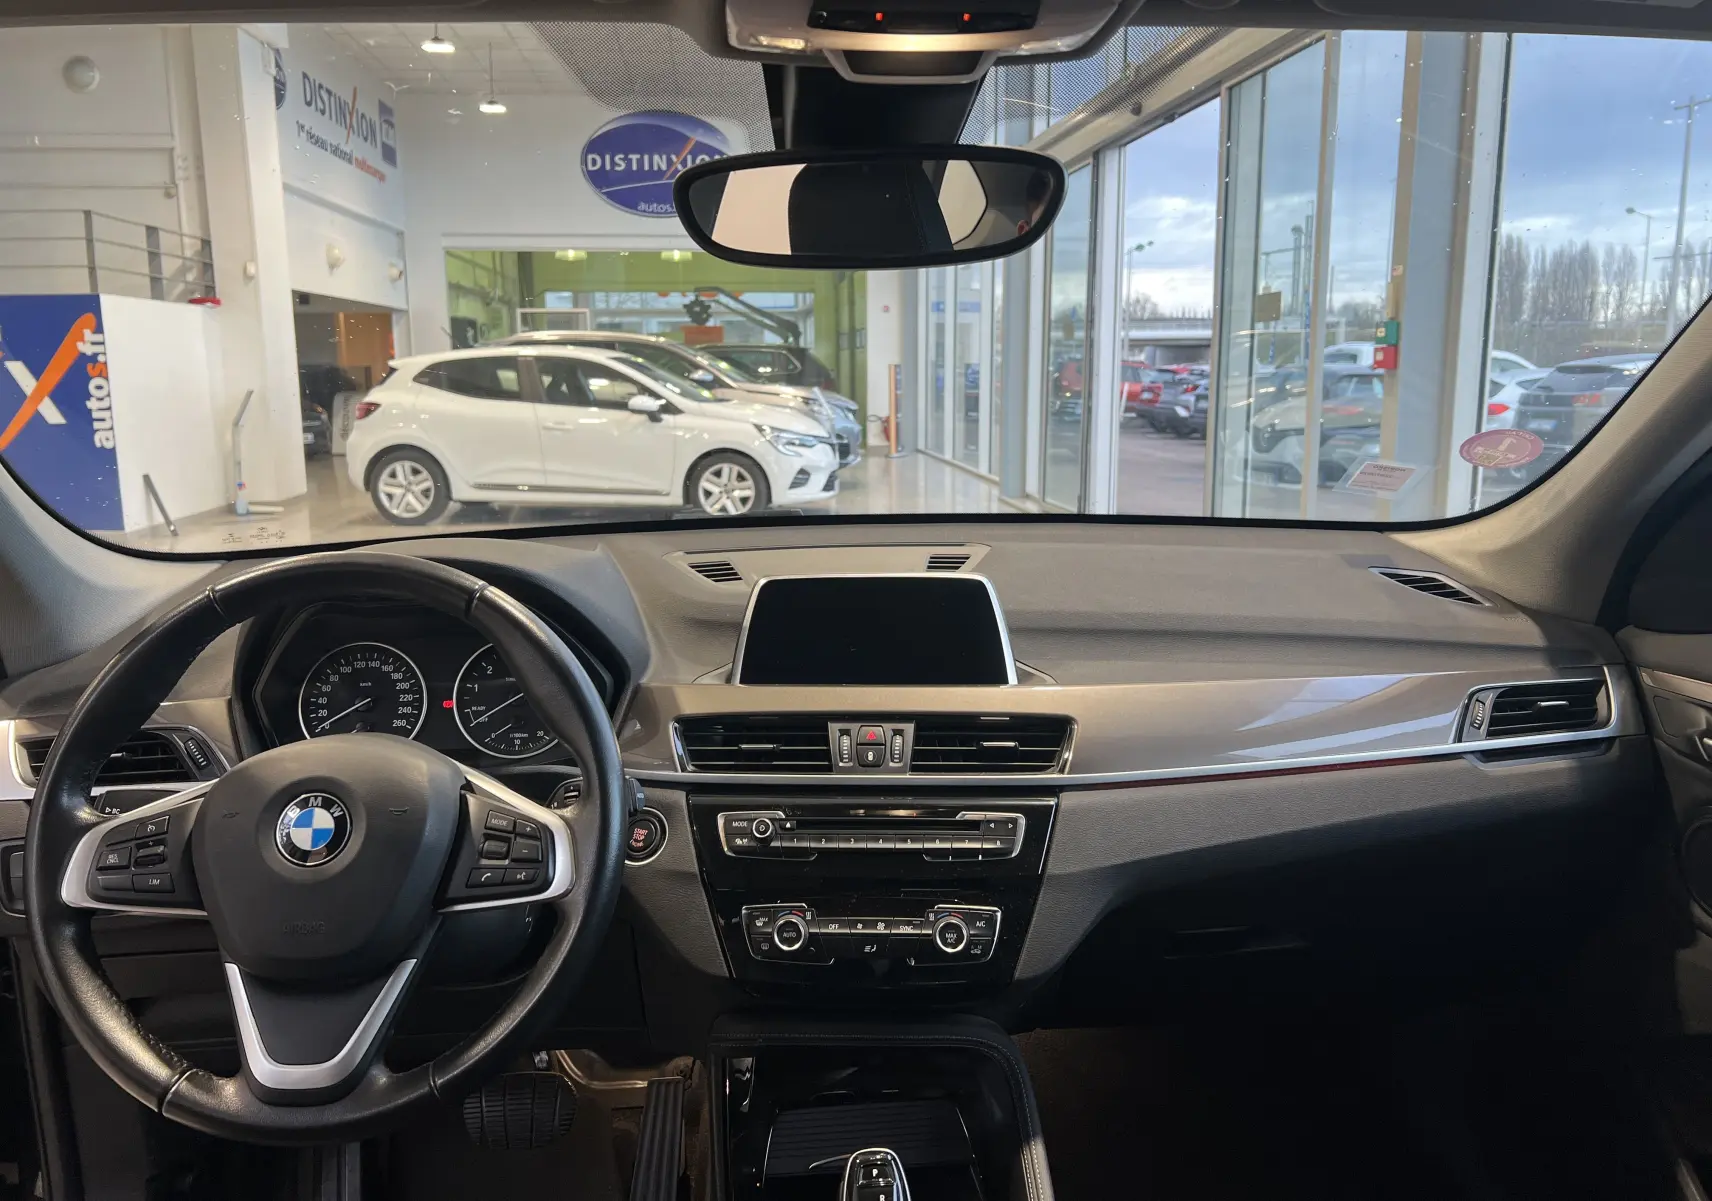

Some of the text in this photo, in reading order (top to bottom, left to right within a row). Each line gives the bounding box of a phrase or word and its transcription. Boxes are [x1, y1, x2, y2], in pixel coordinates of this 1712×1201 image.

[301, 70, 378, 149] DISTINXION
[306, 126, 329, 152] réseau
[329, 141, 354, 165] national
[76, 328, 116, 450] autos.fr
[486, 665, 493, 674] 2
[391, 672, 403, 680] 180
[395, 682, 410, 690] 200
[474, 684, 478, 692] 1
[399, 694, 413, 702] 220
[318, 709, 328, 717] 20
[397, 706, 412, 714] 240
[392, 719, 407, 727] 260
[287, 796, 344, 818] BMW
[491, 817, 509, 826] MODE
[732, 820, 748, 828] MODE
[633, 827, 649, 836] START
[283, 921, 326, 935] AIRBAG
[975, 920, 986, 928] A/C
[872, 1168, 879, 1177] P
